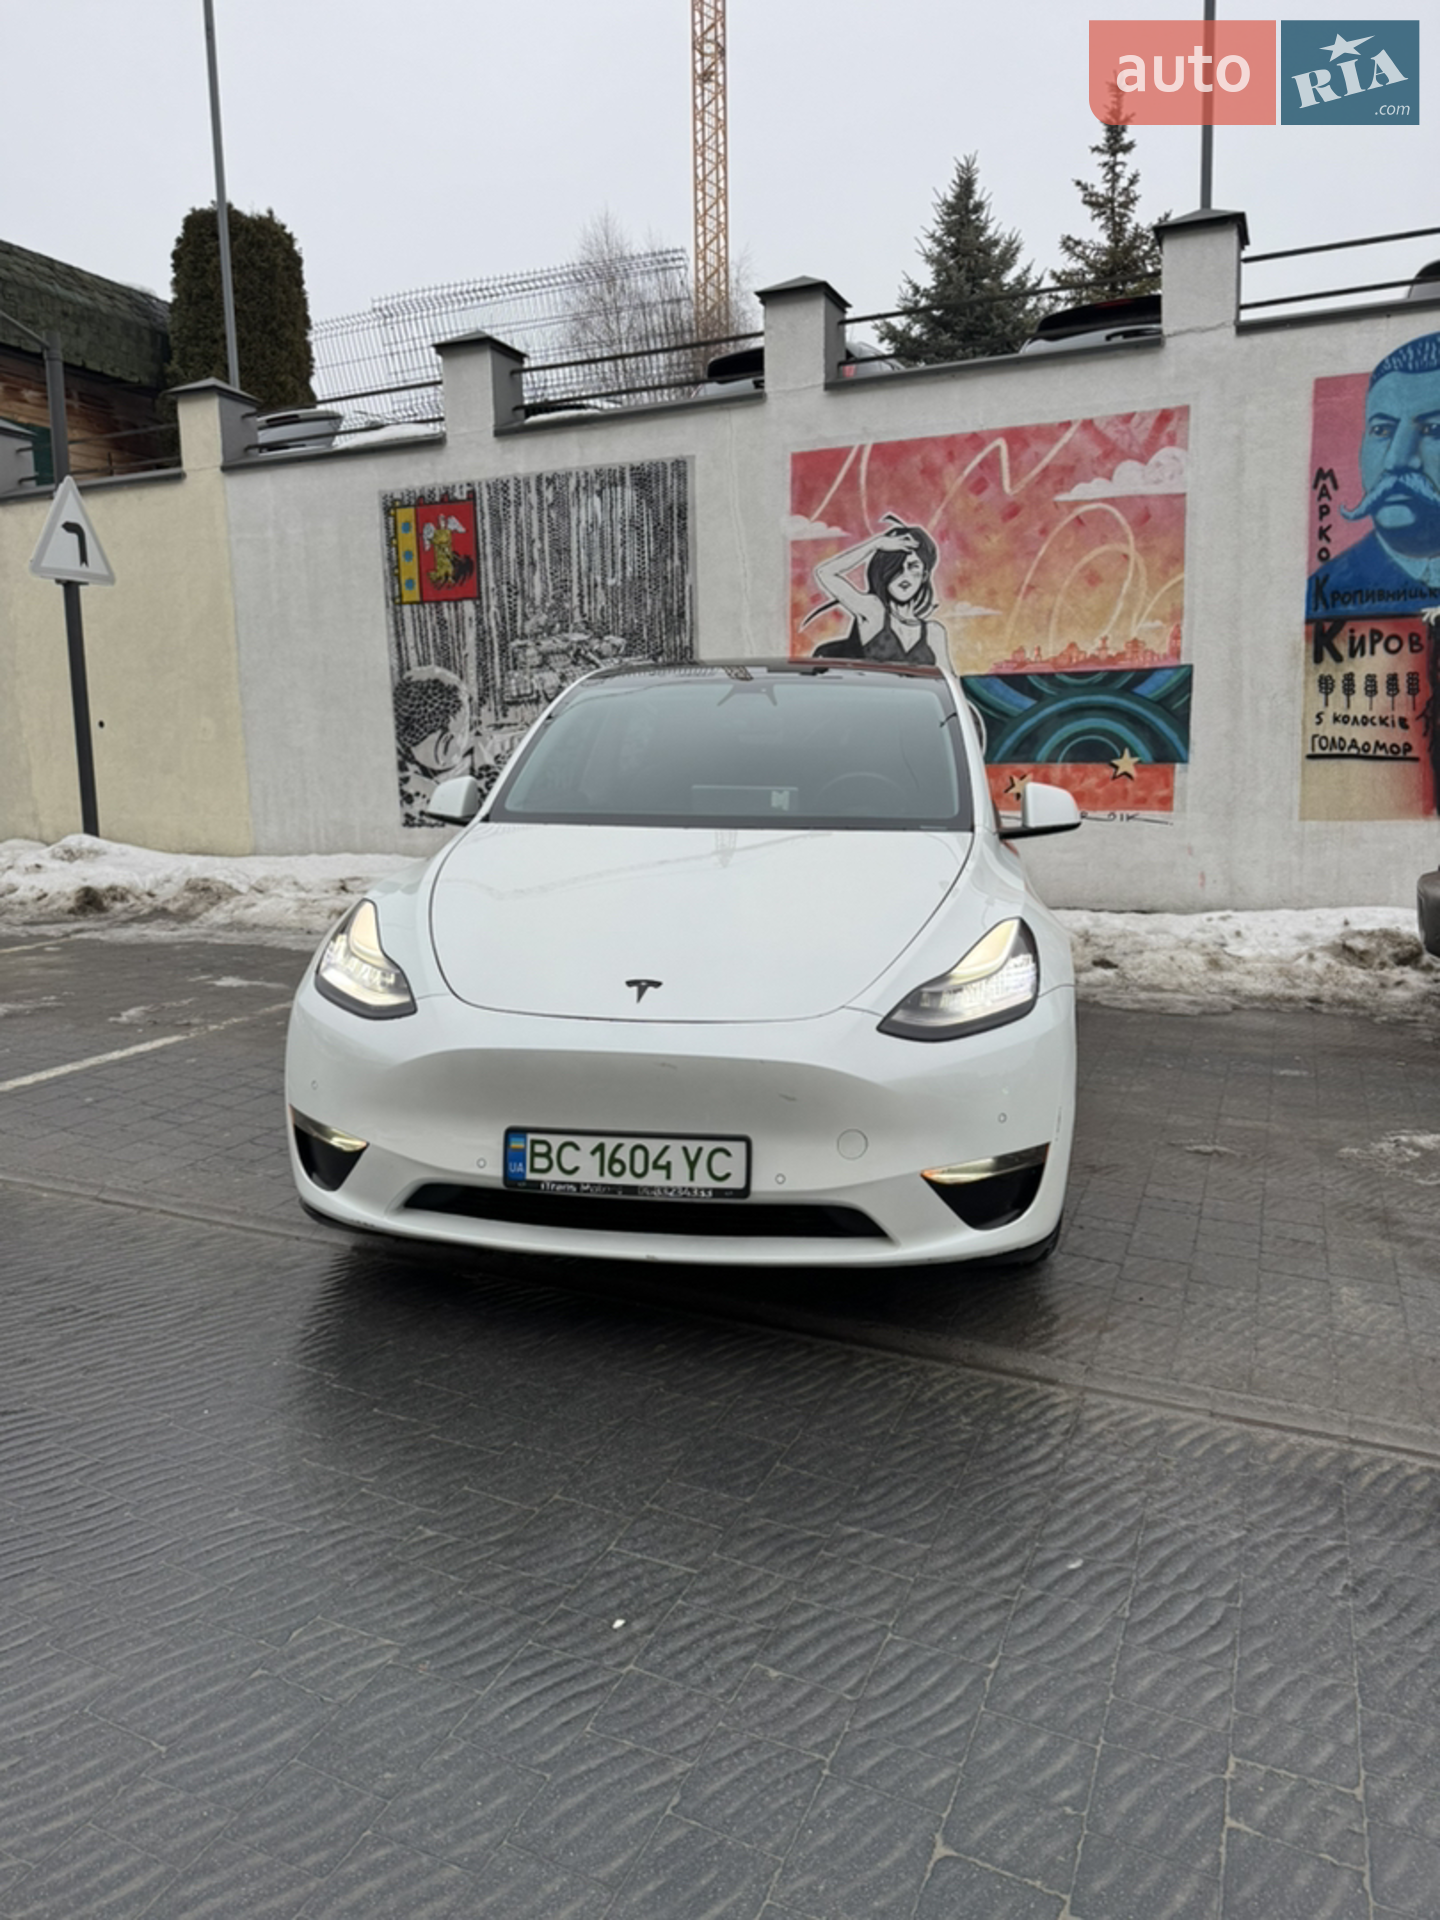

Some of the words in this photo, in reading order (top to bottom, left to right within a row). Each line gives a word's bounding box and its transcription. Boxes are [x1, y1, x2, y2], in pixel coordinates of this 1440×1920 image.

[508, 1162, 524, 1173] UA
[529, 1138, 581, 1175] BC
[590, 1142, 672, 1180] 1604
[682, 1145, 733, 1182] YC
